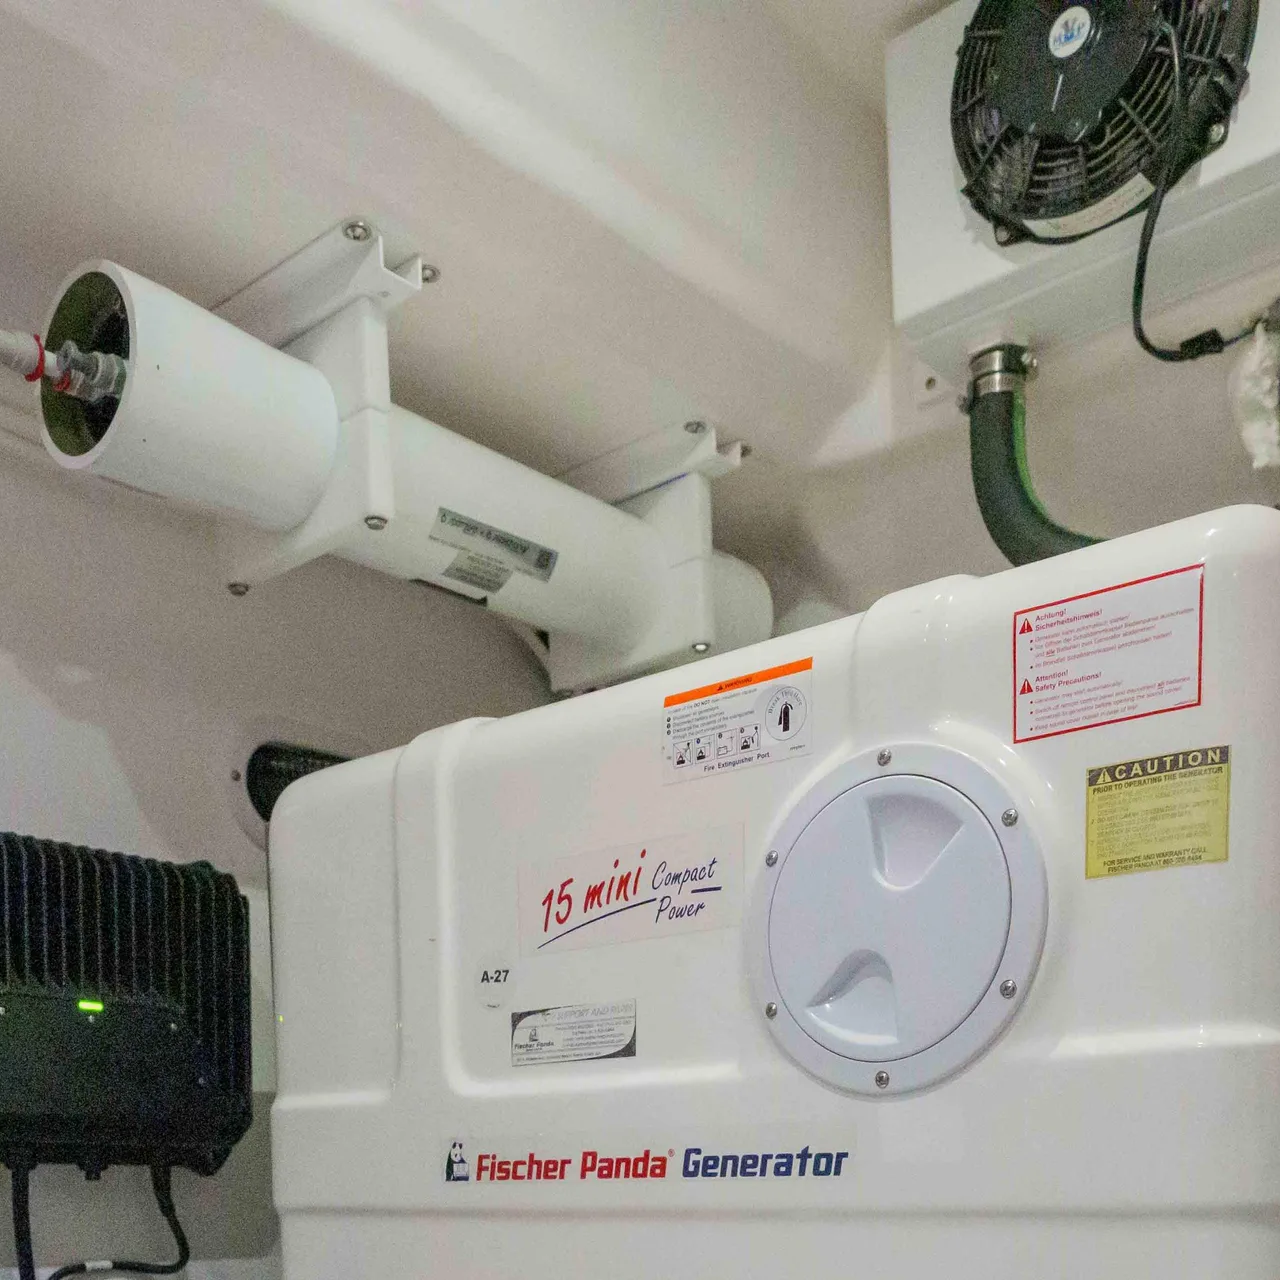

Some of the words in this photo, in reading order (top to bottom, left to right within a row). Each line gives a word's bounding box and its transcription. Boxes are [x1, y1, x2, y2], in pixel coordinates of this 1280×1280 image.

[1035, 684, 1056, 693] Safety
[1058, 671, 1102, 687] Precautions!
[718, 756, 754, 769] Extinguisher
[757, 752, 770, 760] Port
[1114, 748, 1220, 780] CAUTION
[1092, 783, 1113, 795] PRIOR
[1124, 775, 1163, 789] OPERATING
[1116, 855, 1142, 866] SERVICE
[542, 877, 574, 933] 15
[583, 848, 648, 914] mini
[651, 857, 718, 895] Compact
[654, 895, 706, 924] Power
[481, 969, 510, 984] A-27
[476, 1152, 572, 1182] Fischer
[682, 1145, 849, 1179] Generator
